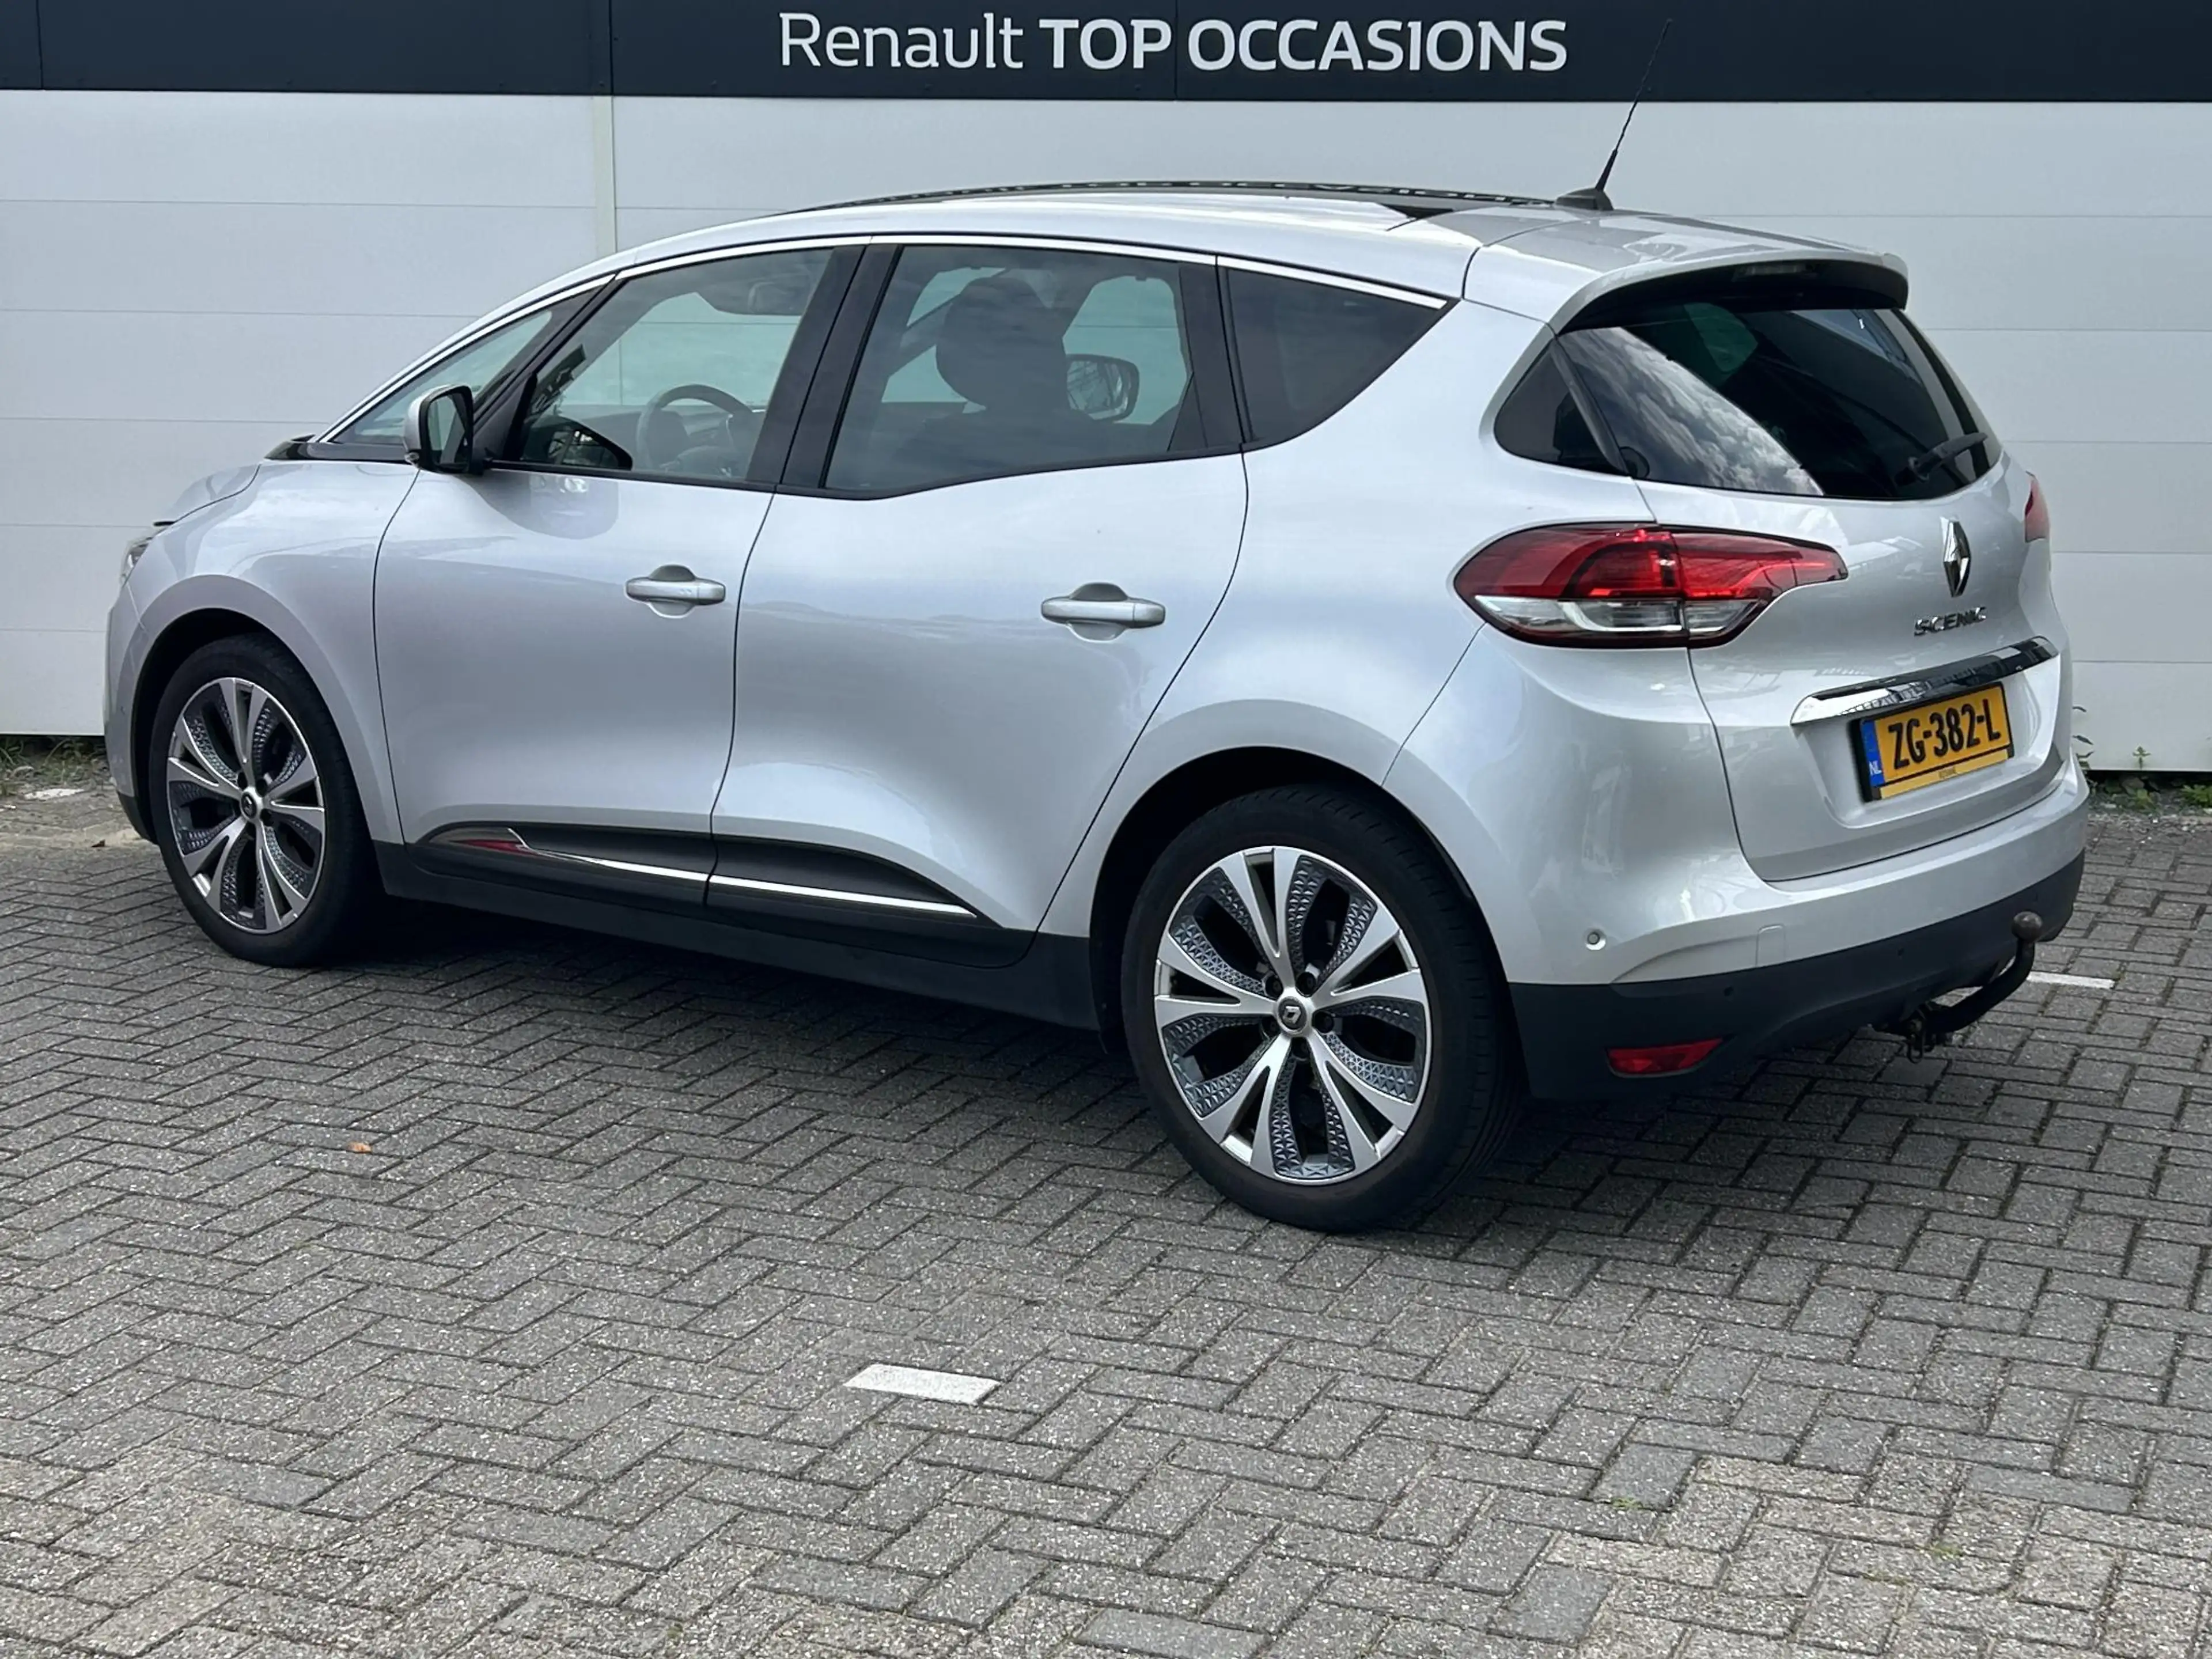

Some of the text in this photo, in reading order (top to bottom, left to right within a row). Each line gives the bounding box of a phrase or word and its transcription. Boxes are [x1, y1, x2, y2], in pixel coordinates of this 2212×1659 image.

[779, 13, 1567, 71] Renault TOP OCCASIONS
[1914, 607, 1987, 637] SCENIC
[1888, 699, 2001, 770] ZG-382-L
[1868, 760, 1882, 775] NL
